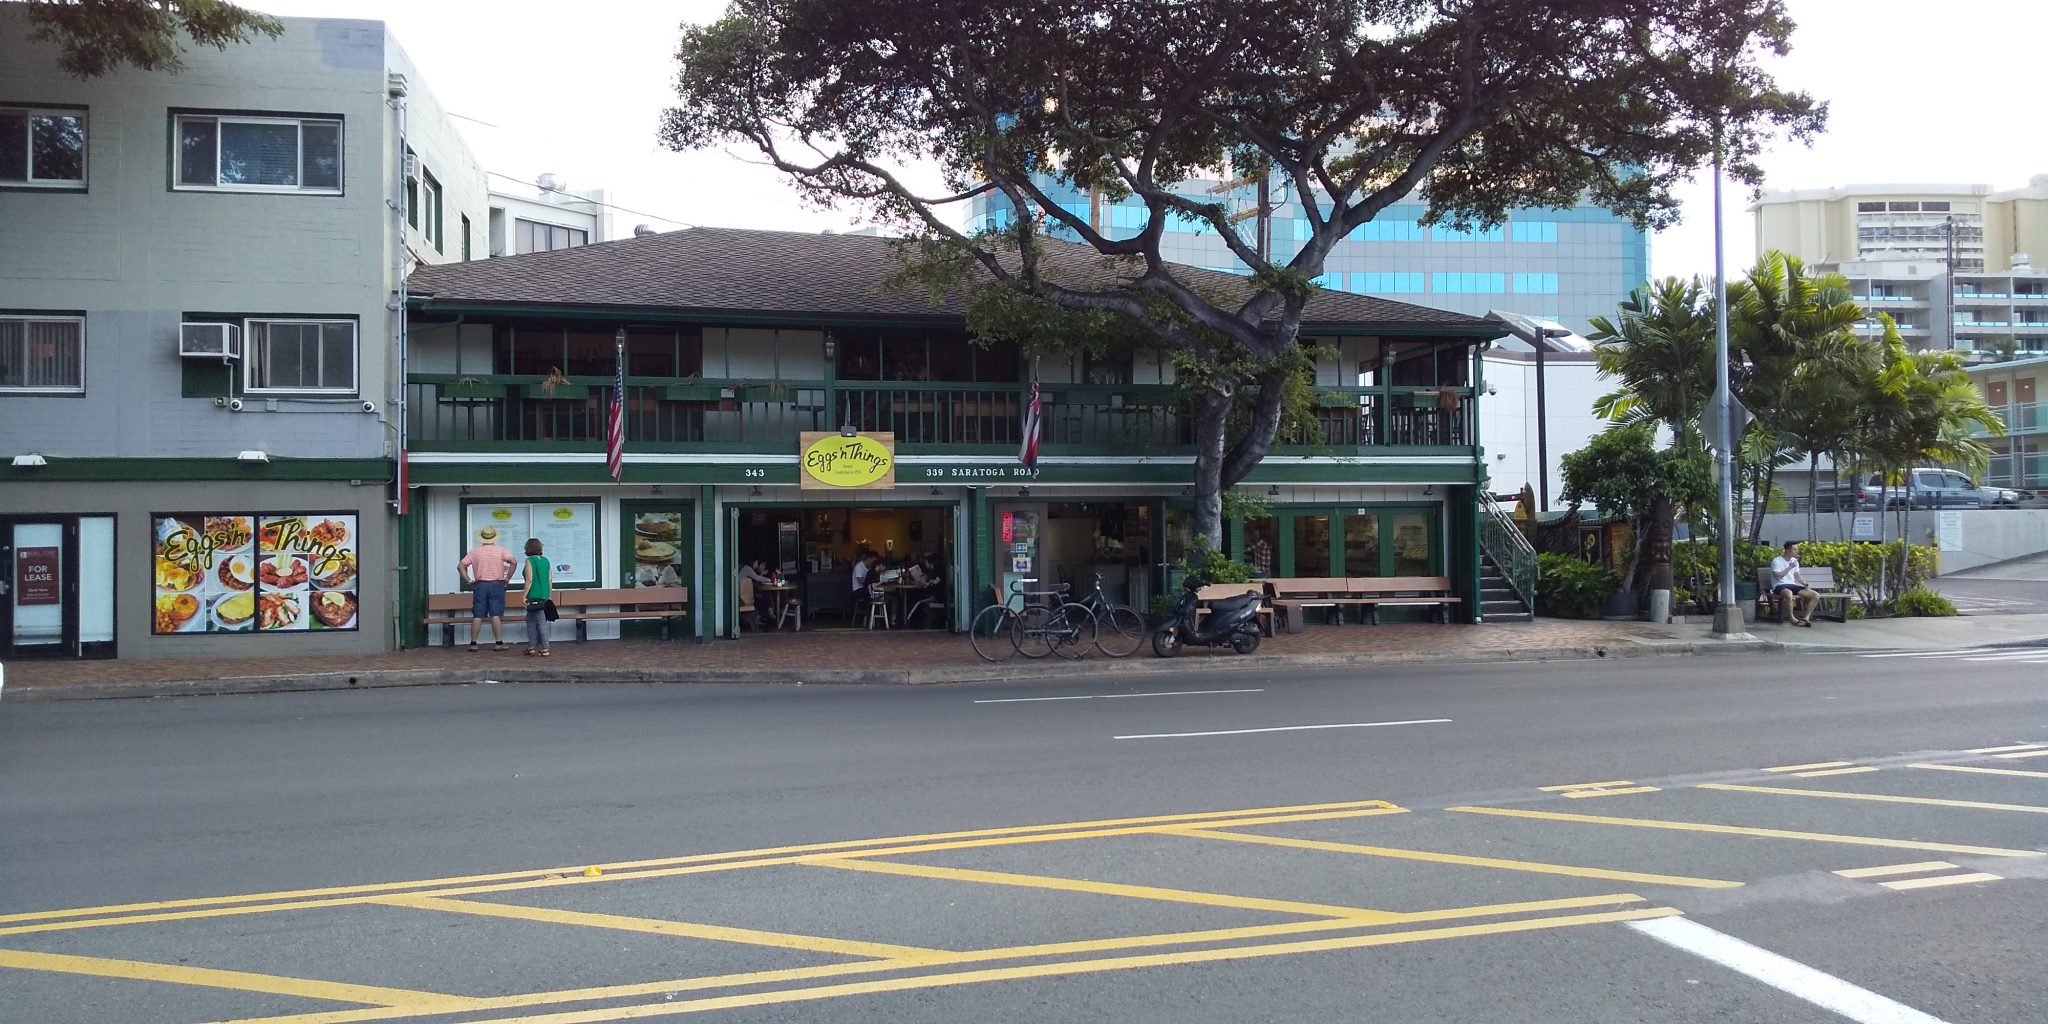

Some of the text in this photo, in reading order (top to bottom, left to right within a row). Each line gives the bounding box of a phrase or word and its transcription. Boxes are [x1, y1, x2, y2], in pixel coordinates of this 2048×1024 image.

[745, 468, 765, 477] 343
[926, 468, 1040, 477] 339 SARATOGA ROAD
[264, 517, 352, 577] Things
[28, 565, 48, 573] FOR
[24, 573, 53, 582] LEASE
